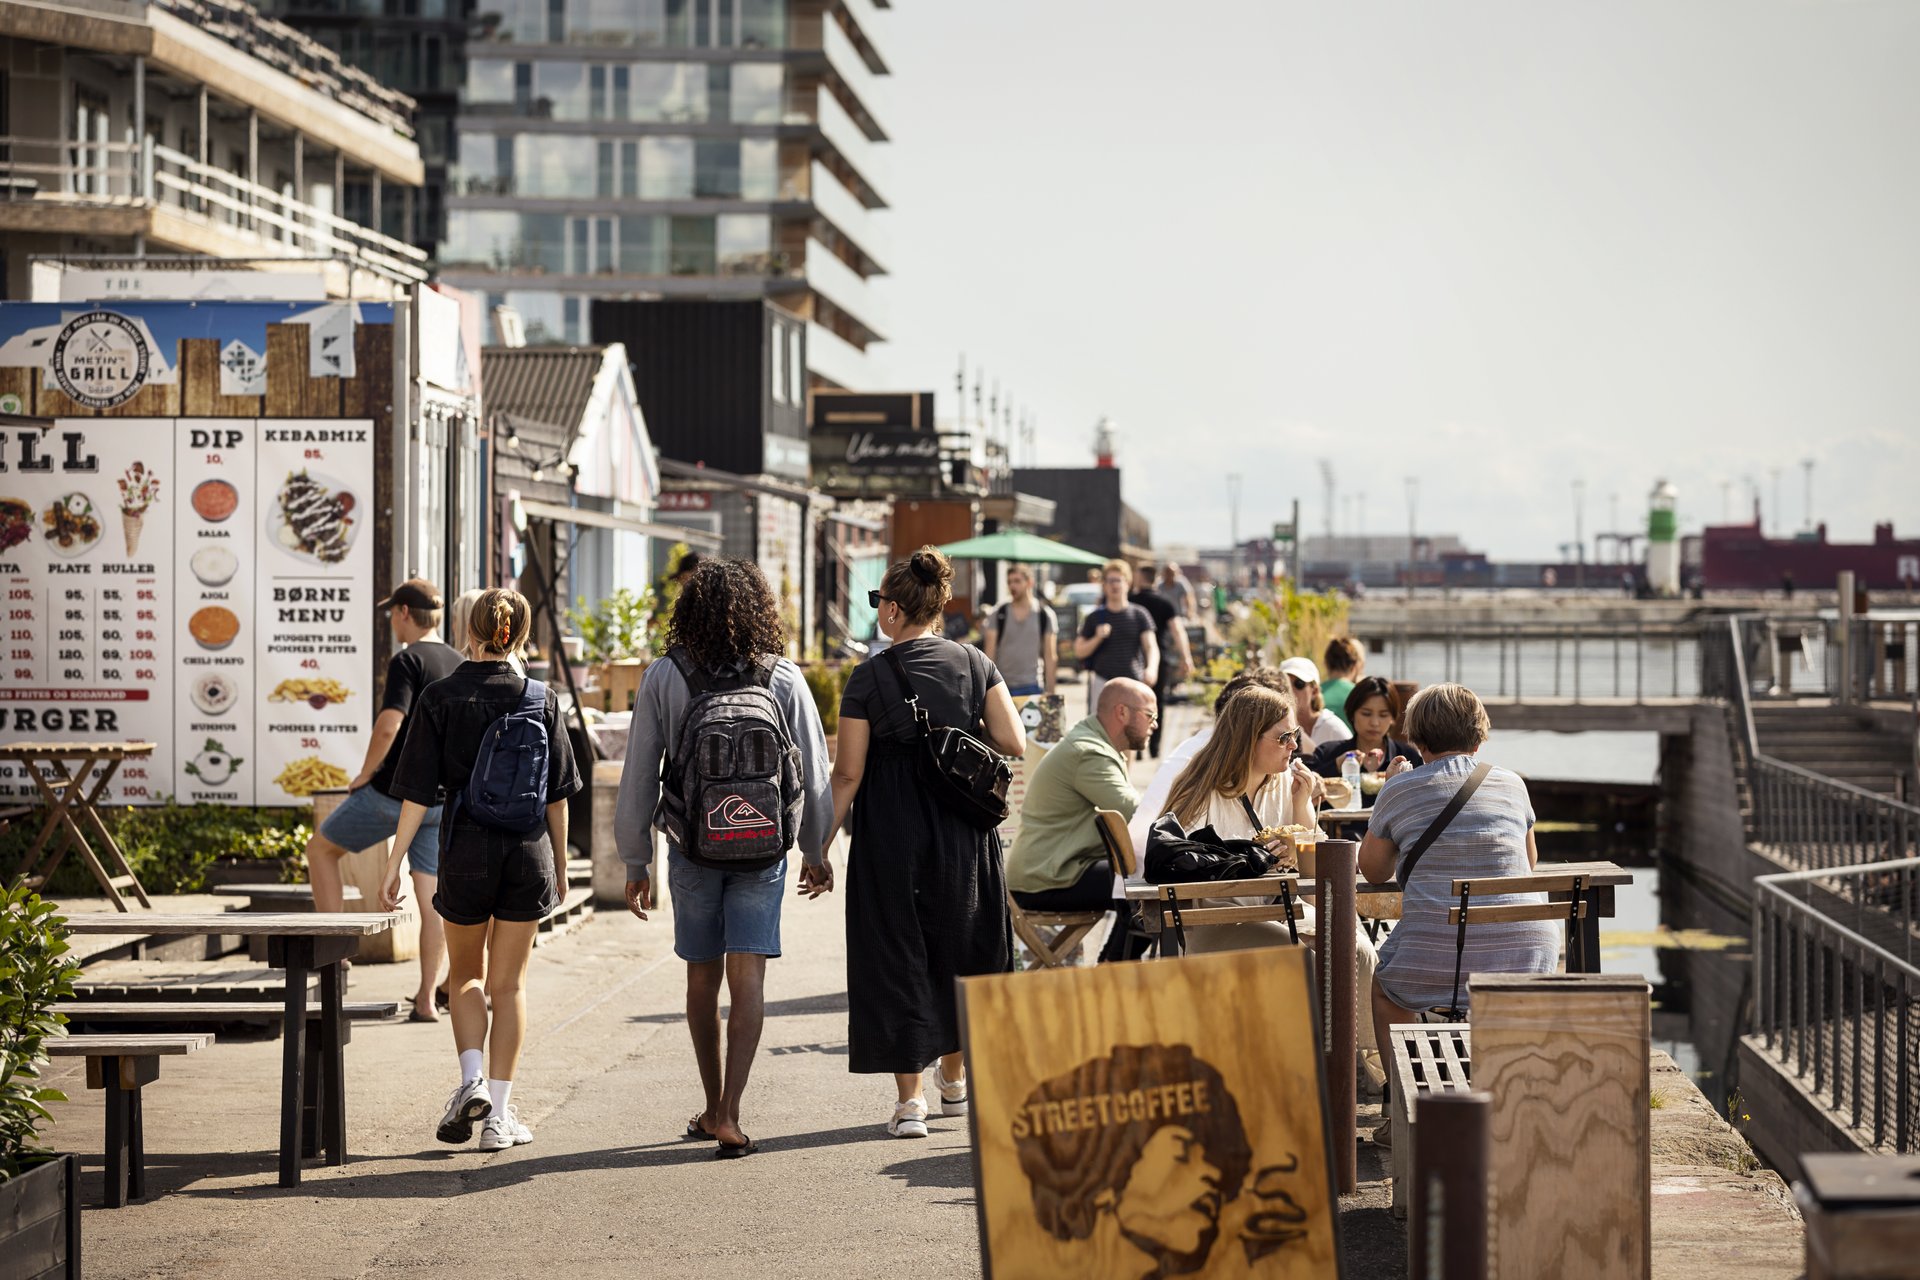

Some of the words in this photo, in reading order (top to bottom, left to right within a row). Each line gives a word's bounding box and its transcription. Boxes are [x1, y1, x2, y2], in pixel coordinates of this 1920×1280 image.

[71, 367, 130, 380] GRILL
[190, 430, 243, 448] DIP
[265, 430, 367, 442] KEBABMIX
[48, 563, 91, 574] PLATE
[102, 563, 155, 574] RULLER
[273, 587, 351, 603] BØRNE
[278, 608, 345, 623] MENU
[273, 634, 324, 643] NUGGETS
[328, 634, 352, 643] MED
[268, 645, 315, 654] POMMES
[318, 644, 357, 653] FRITES
[15, 690, 50, 699] FRITES
[53, 690, 68, 699] OG
[70, 690, 126, 699] SODAVAND
[191, 723, 237, 731] HUMMUS
[268, 724, 315, 733] POMMES
[320, 723, 358, 732] FRITES
